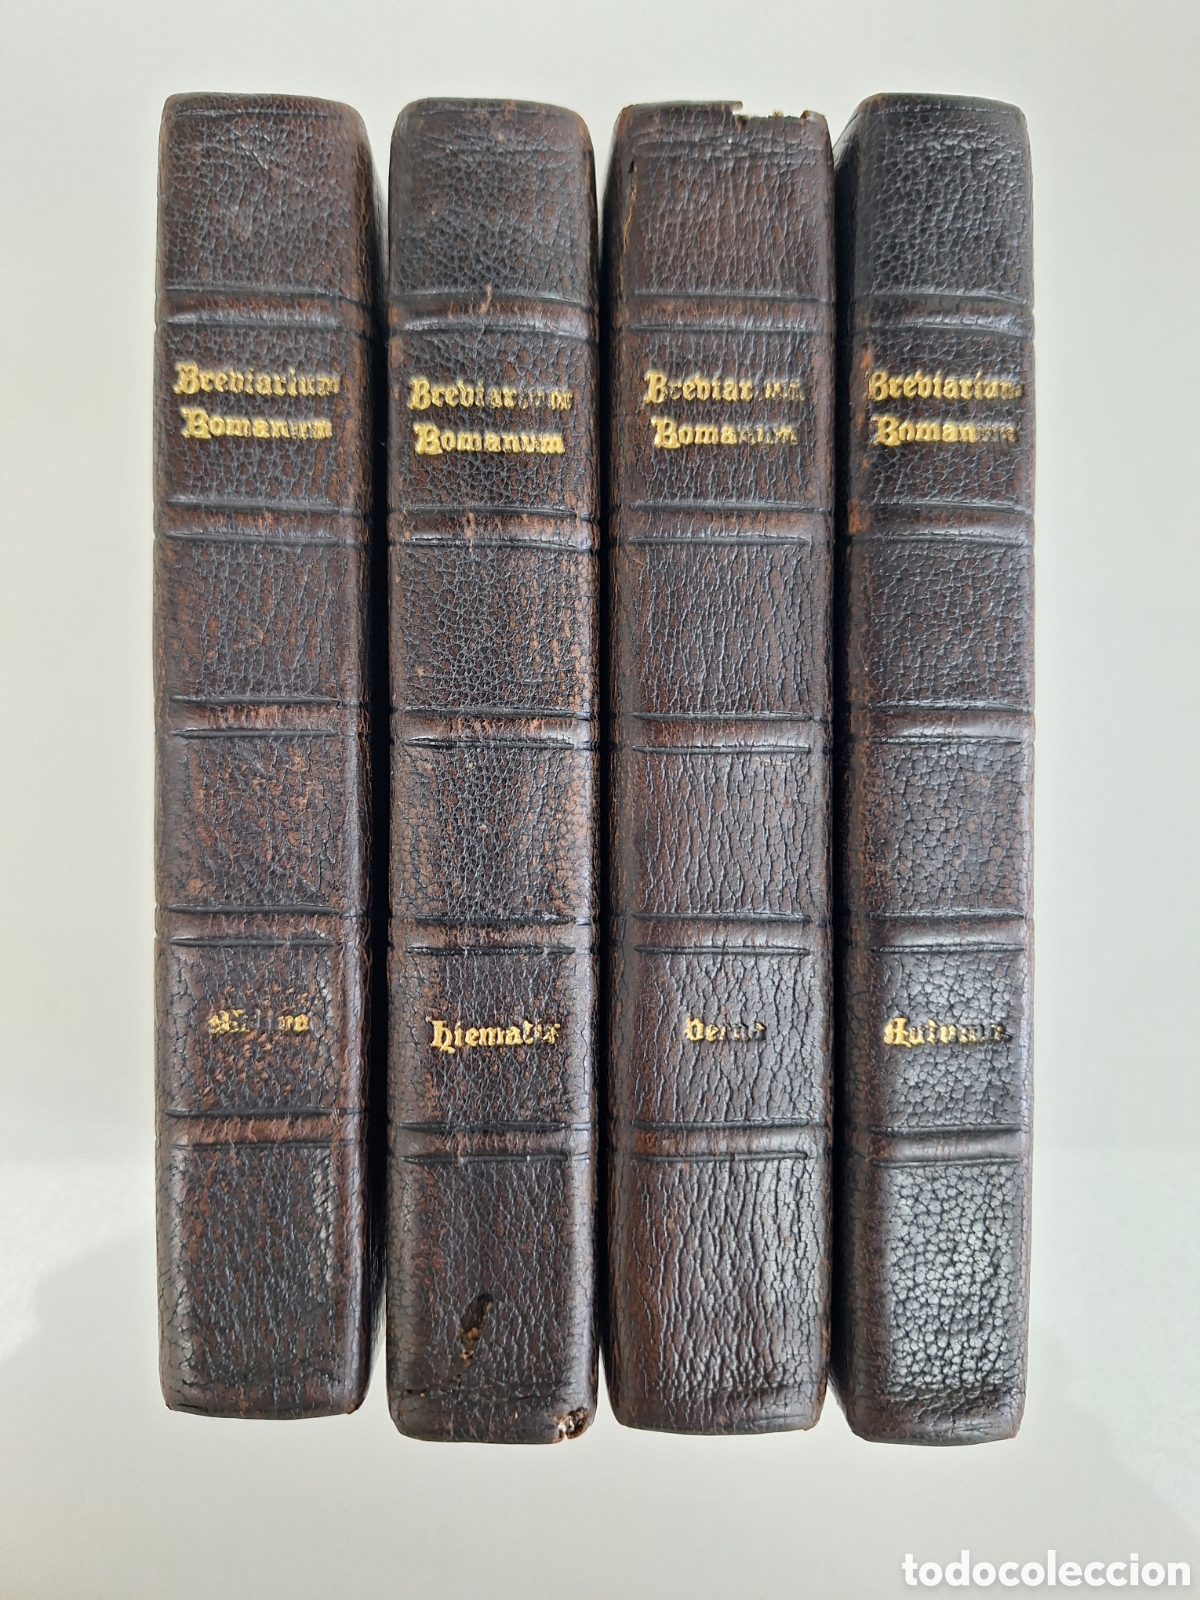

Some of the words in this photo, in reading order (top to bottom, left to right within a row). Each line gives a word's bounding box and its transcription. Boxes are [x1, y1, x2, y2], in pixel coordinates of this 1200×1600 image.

[172, 361, 339, 396] Breviarium
[643, 369, 806, 404] Breviarum
[868, 370, 1022, 402] Breviarium
[179, 406, 332, 440] Romanum
[412, 422, 565, 455] Romanum
